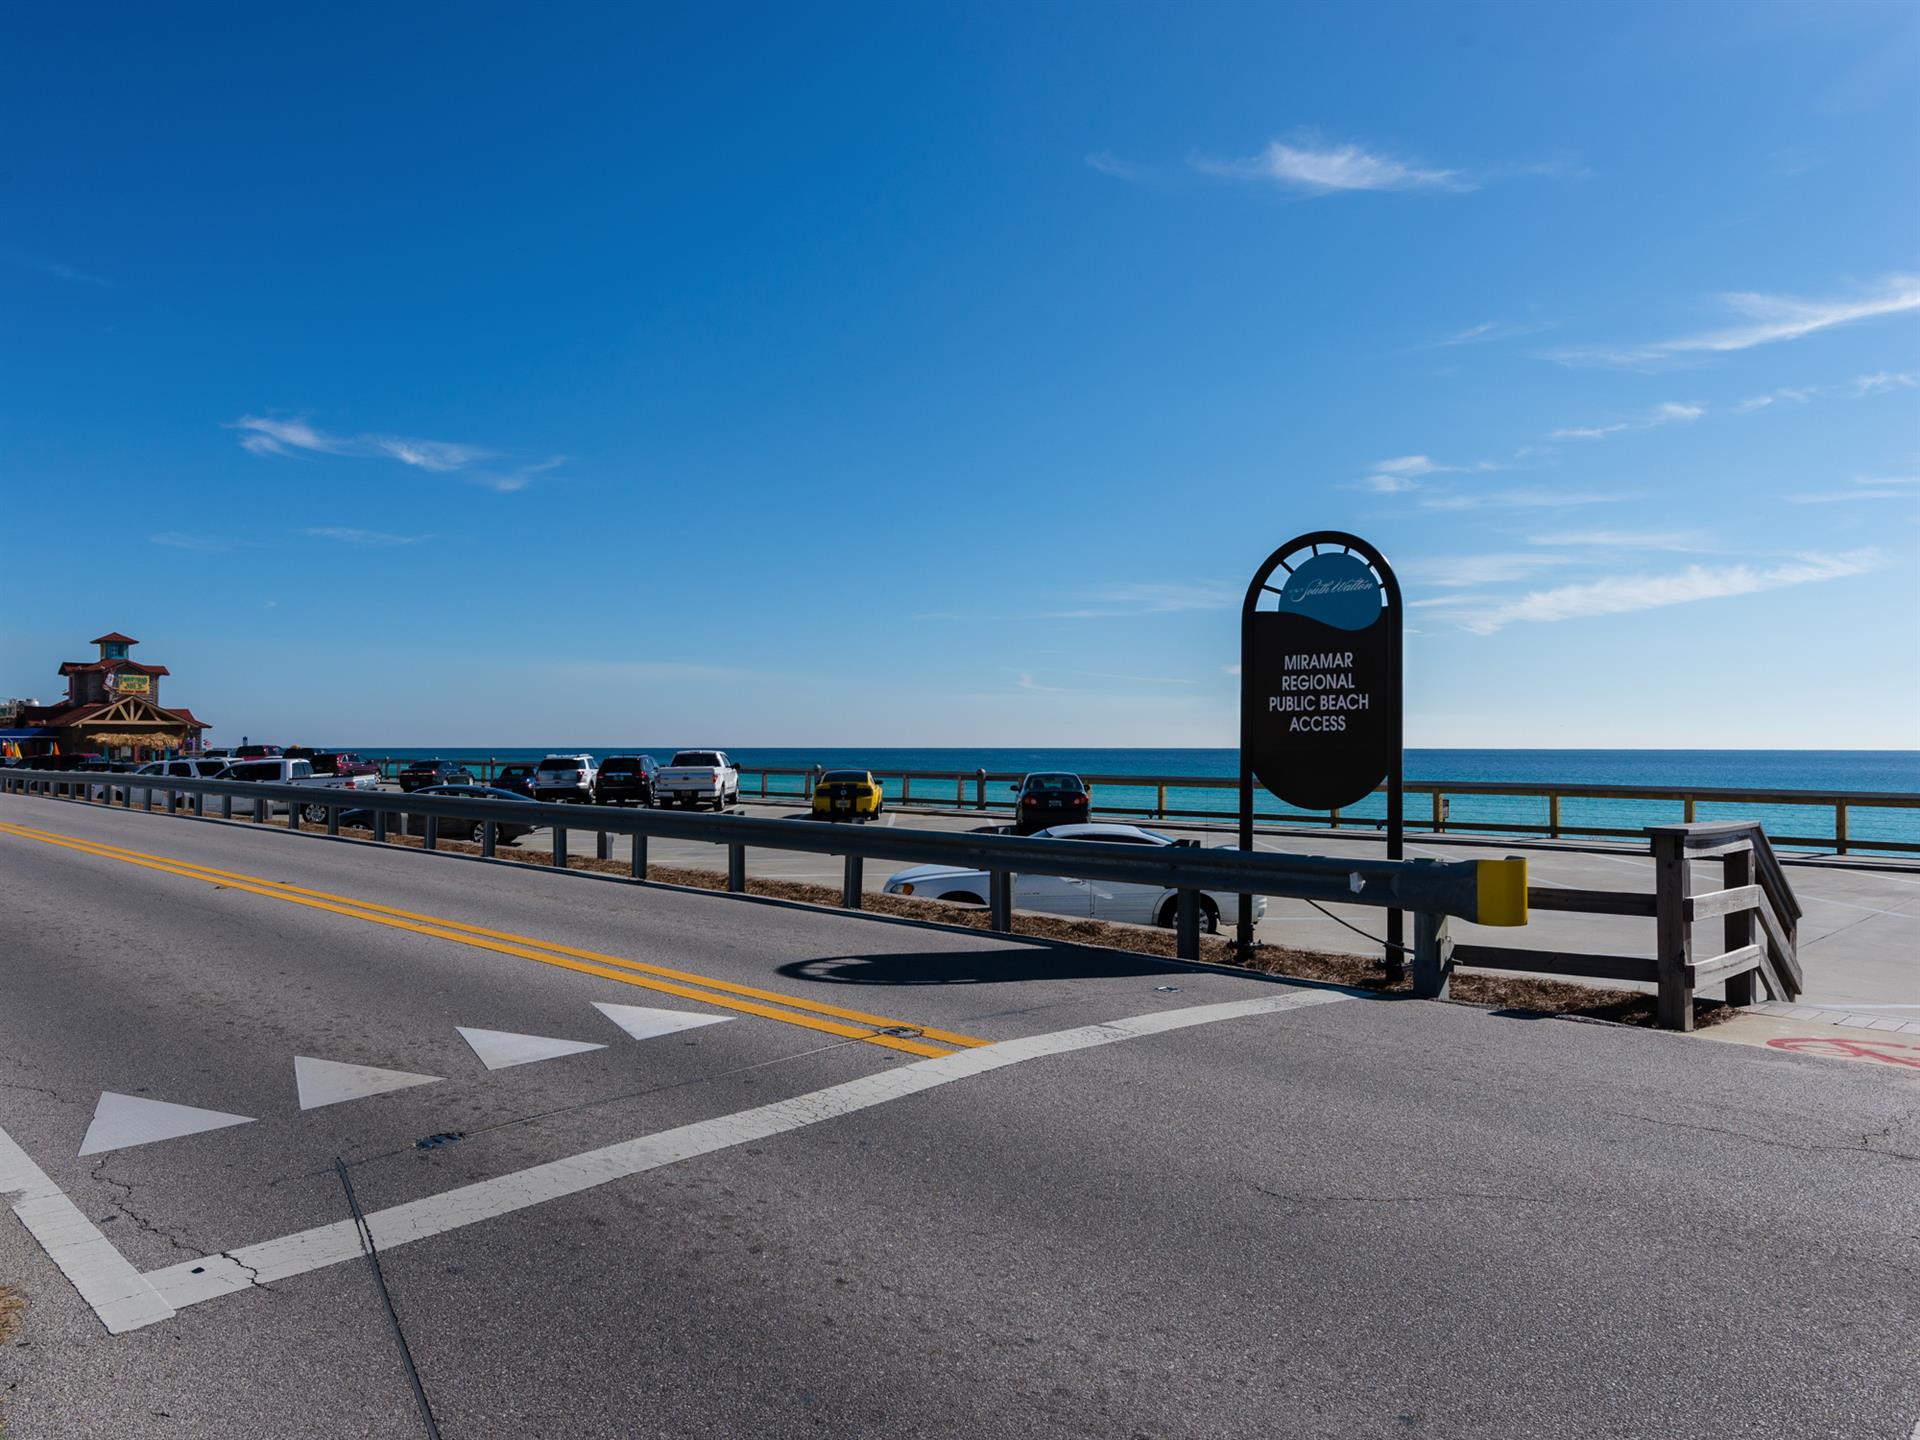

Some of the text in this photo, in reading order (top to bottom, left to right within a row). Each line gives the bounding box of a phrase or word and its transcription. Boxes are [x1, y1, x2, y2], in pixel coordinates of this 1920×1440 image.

[1291, 578, 1373, 602] South Walton
[1284, 652, 1353, 671] MIRAMAR
[1282, 673, 1355, 691] REGIONAL
[1269, 693, 1369, 712] PUBLIC BEACH
[1289, 715, 1346, 731] ACCESS
